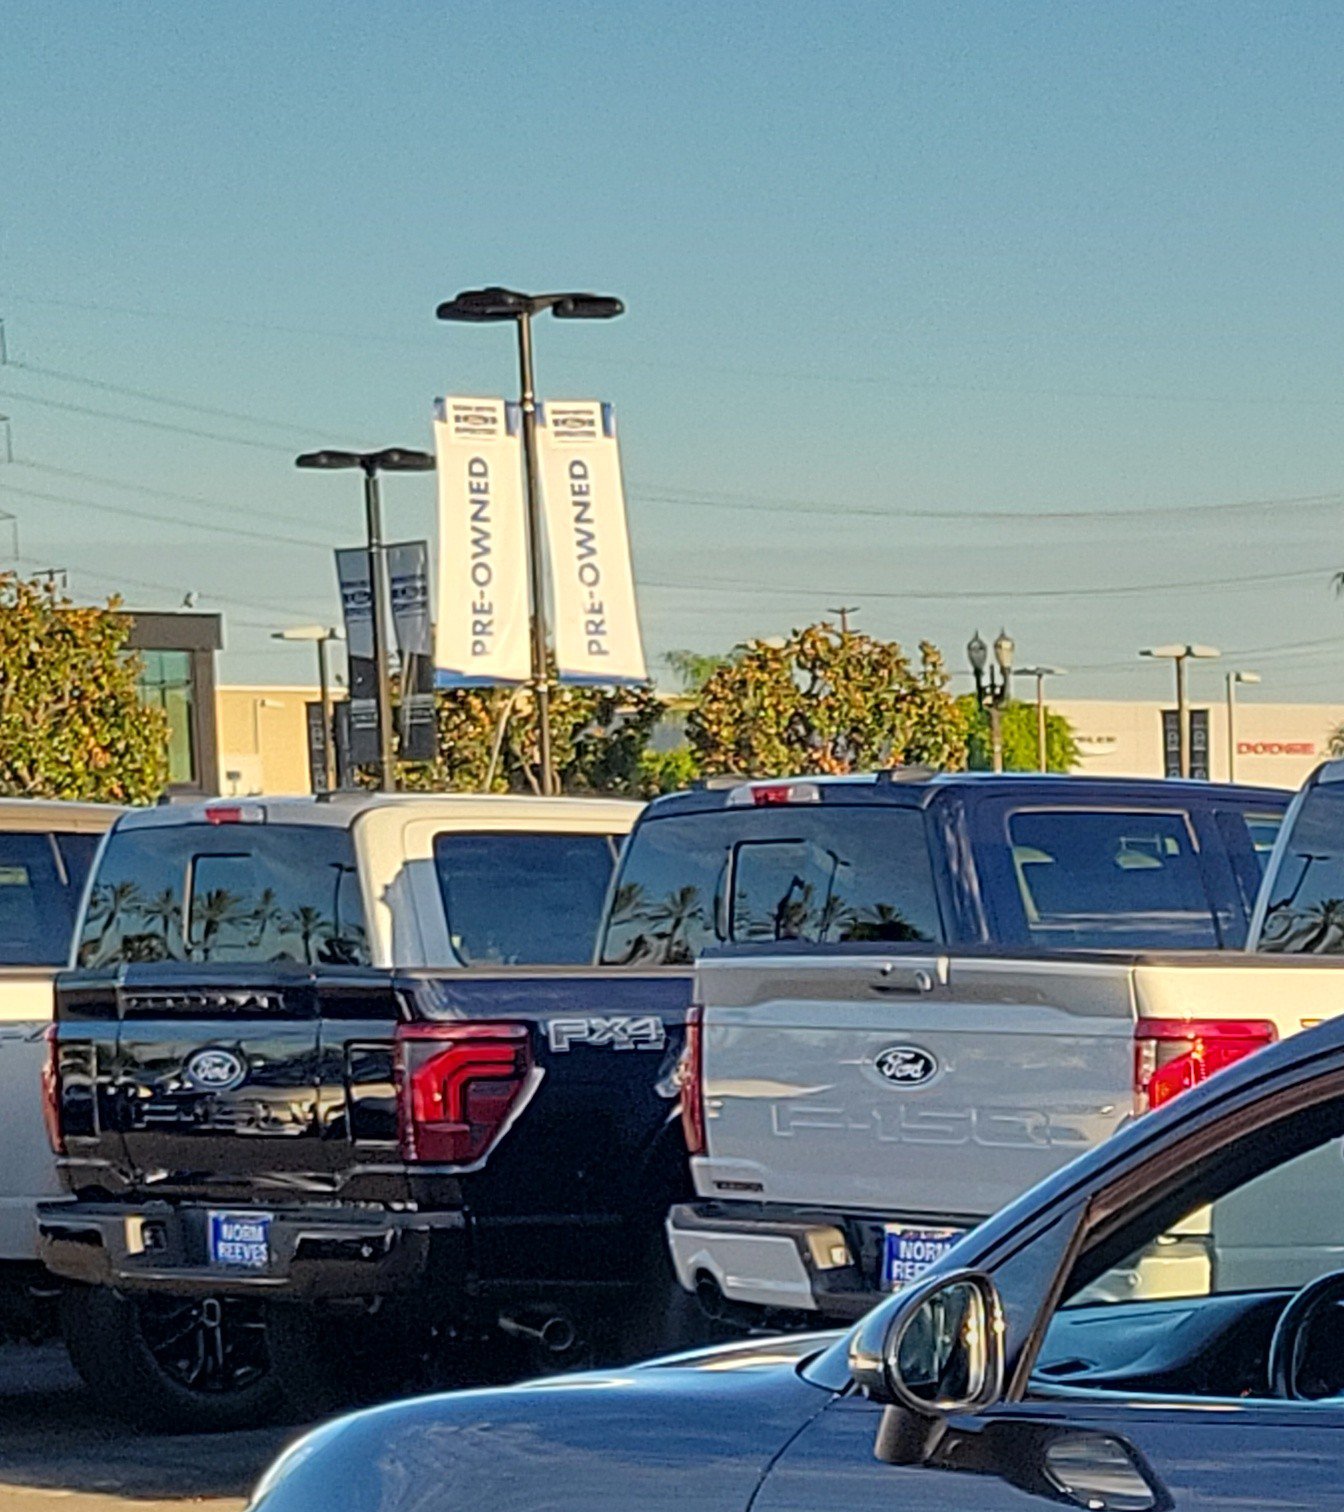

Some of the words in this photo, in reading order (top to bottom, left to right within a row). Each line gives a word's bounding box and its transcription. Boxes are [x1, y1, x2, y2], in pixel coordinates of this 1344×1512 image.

[468, 456, 493, 656] PRE-OWNED
[569, 459, 609, 656] PRE-OWNED
[1236, 742, 1314, 755] DODGE
[548, 1016, 666, 1053] FX4
[880, 1048, 930, 1081] Ford
[222, 1223, 264, 1242] NORM
[218, 1241, 269, 1262] REEVES
